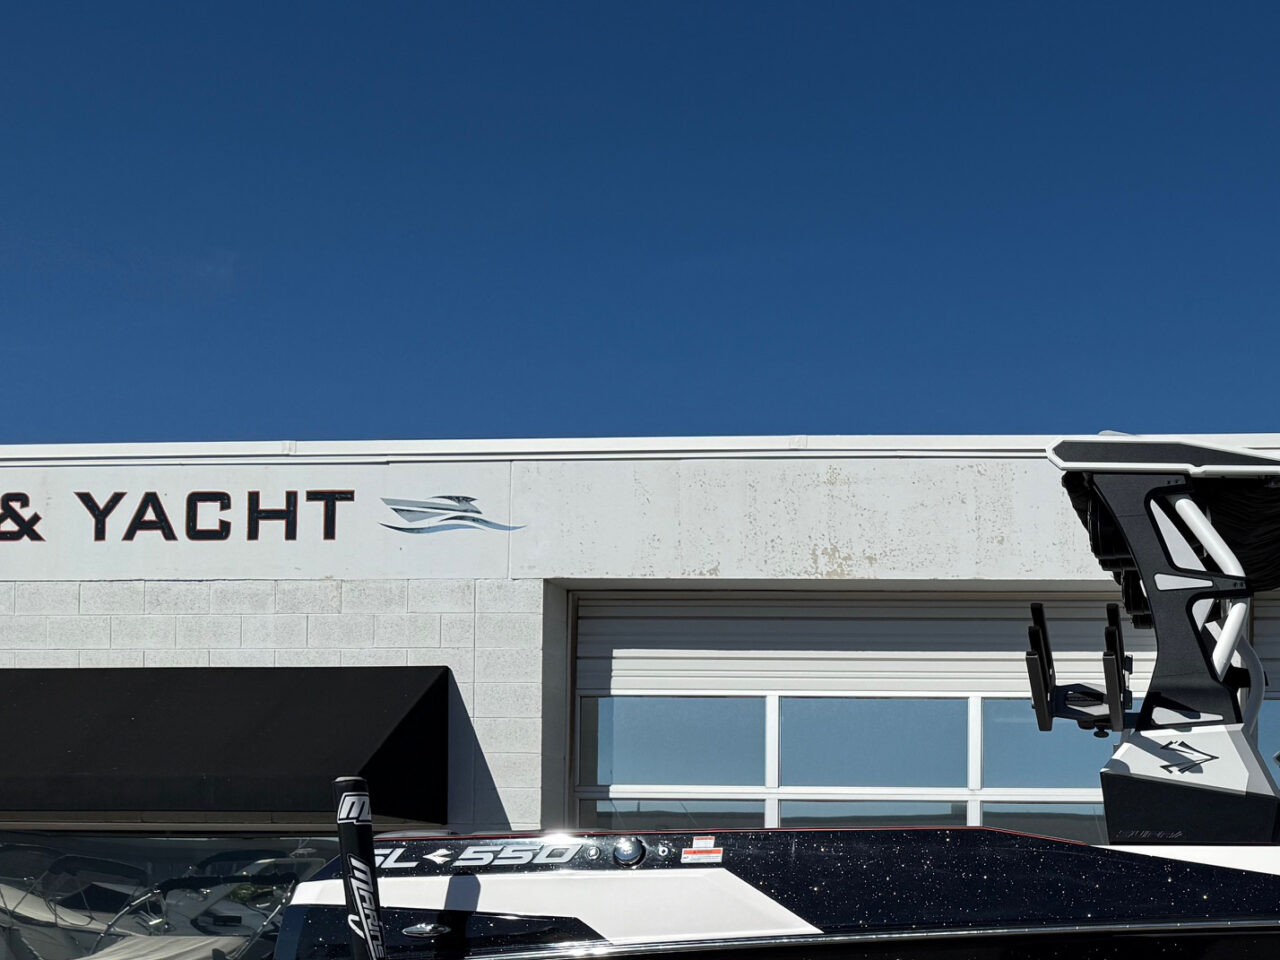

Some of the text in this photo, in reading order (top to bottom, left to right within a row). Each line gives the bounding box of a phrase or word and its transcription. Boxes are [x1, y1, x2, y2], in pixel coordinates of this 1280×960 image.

[0, 490, 355, 541] & YACHT
[452, 845, 583, 866] 550
